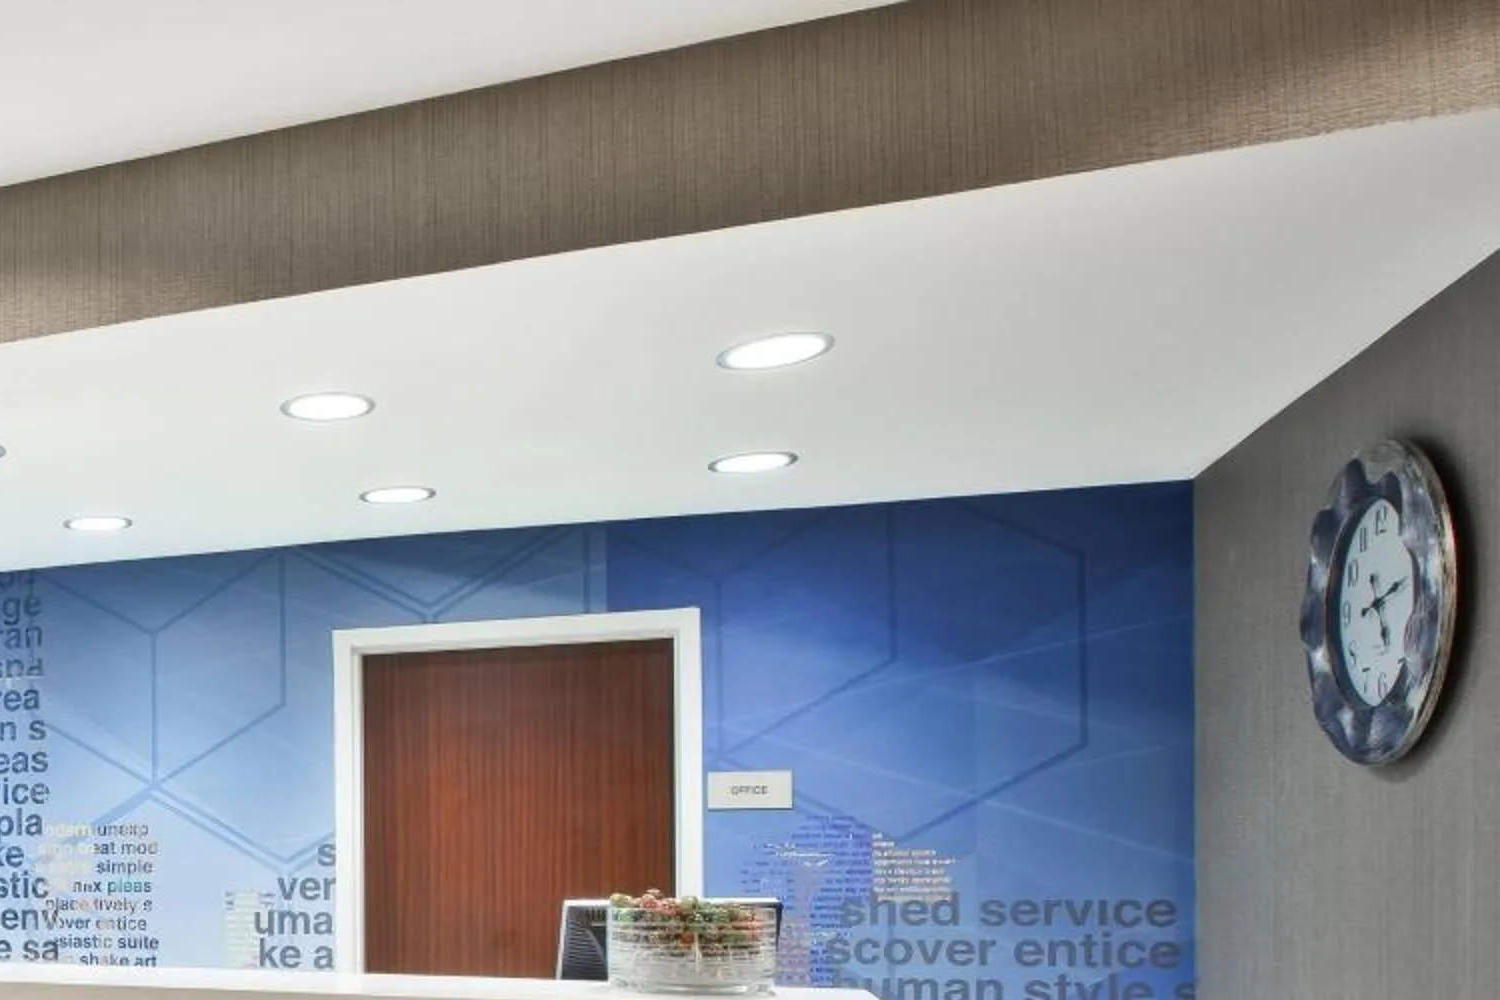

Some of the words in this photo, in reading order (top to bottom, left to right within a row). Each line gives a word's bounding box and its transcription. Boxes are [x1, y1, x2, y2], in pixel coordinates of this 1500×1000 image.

[29, 719, 48, 741] s
[95, 859, 154, 875] simple
[107, 879, 152, 896] pleas
[277, 877, 336, 901] ver
[1, 908, 59, 931] env
[841, 890, 960, 927] shed
[980, 896, 1178, 928] service
[254, 909, 333, 937] uma
[22, 936, 60, 963] sa
[117, 935, 160, 950] suite
[259, 938, 303, 969] ke
[313, 945, 334, 969] a
[827, 937, 997, 966] scover
[1013, 931, 1181, 970] entice
